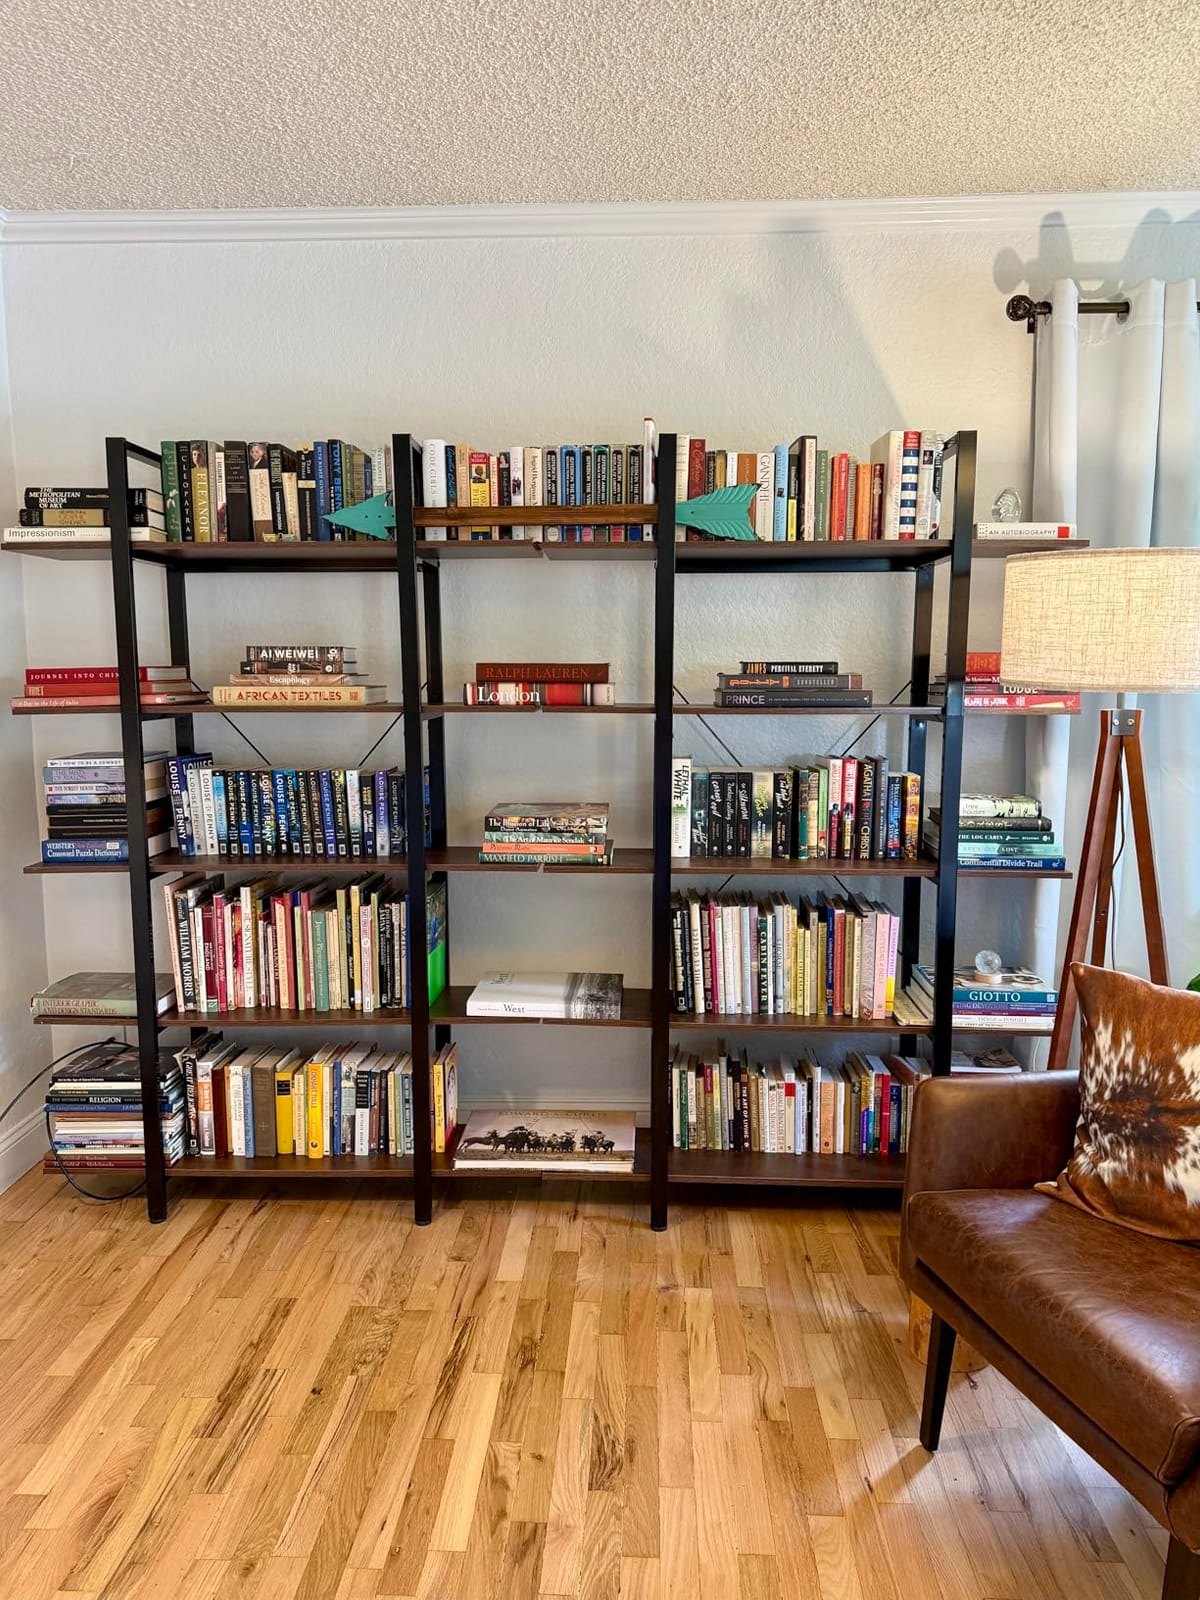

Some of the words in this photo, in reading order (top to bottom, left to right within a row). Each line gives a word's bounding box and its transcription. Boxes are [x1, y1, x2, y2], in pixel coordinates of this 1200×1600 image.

[333, 443, 341, 474] TONY
[759, 455, 771, 502] GANDHI
[28, 491, 81, 500] METROPOLITAN
[181, 455, 192, 533] CLEOPATRA
[197, 473, 209, 534] ELEANOR
[8, 528, 76, 539] Impressionism
[1001, 529, 1056, 537] AUTOBIOGRAPHY
[260, 649, 272, 659] AI
[275, 649, 319, 659] WEIWEI
[30, 671, 69, 681] JOURNEY
[73, 671, 95, 680] INTO
[98, 671, 120, 679] CHIN
[485, 666, 530, 679] RALPH
[535, 667, 590, 679] LAUREN
[745, 662, 767, 674] JAMES
[798, 663, 824, 673] EVERETT
[236, 690, 288, 702] AFRICAN
[290, 690, 342, 702] TEXTILES
[477, 686, 540, 703] London
[725, 695, 766, 705] PRINCE
[189, 777, 199, 806] LOUISE
[202, 773, 212, 802] LOUISE
[227, 776, 235, 802] LOUISE
[261, 774, 271, 805] LOUISE
[276, 773, 285, 804] LOUISE
[287, 776, 295, 801] LOUISE
[298, 777, 306, 801] LOUISE
[309, 777, 317, 802] LOUISE
[321, 778, 329, 802] LOUISE
[334, 778, 342, 803] LOUISE
[378, 776, 386, 801] LOUISE
[673, 769, 682, 801] WHITE
[681, 765, 690, 797] LETHAL
[863, 764, 873, 797] AGATHA
[168, 760, 181, 795] LOUISE
[175, 808, 187, 840] PENNY
[391, 780, 399, 806] LOUISE
[289, 801, 297, 826] PENNY
[300, 802, 308, 826] PENNY
[312, 802, 320, 826] PENNY
[324, 803, 332, 827] PENNY
[336, 803, 344, 828] PENNY
[378, 802, 387, 825] PENNY
[392, 806, 400, 830] PENNY
[488, 818, 501, 828] The
[192, 813, 201, 841] PENNY
[206, 813, 215, 841] PENNY
[264, 815, 273, 843] PENNY
[278, 814, 287, 842] PENNY
[971, 833, 984, 841] LOG
[984, 833, 1004, 841] CABIN
[75, 848, 94, 858] Puzzle
[95, 848, 123, 858] Dictionary
[860, 825, 871, 860] CHRISTIE
[1001, 846, 1019, 854] LOST
[483, 853, 526, 864] MAXFIELD
[527, 854, 563, 864] PARRISH
[959, 858, 1003, 868] Continental
[1002, 858, 1027, 868] Divide
[1026, 859, 1043, 869] Trail
[178, 920, 190, 958] WILLIAM
[759, 931, 768, 964] CABIN
[183, 961, 194, 997] MORRIS
[760, 968, 769, 1002] FEVER
[41, 998, 71, 1008] INTERIOR
[71, 999, 98, 1008] GRAPHIC
[502, 1003, 525, 1014] West
[968, 990, 1022, 1003] GIOTTO
[43, 1006, 60, 1015] AND
[60, 1006, 78, 1015] DESIGN
[78, 1006, 117, 1016] STANDARDS
[184, 1060, 195, 1084] GREAT
[88, 1096, 122, 1104] RELIGION
[185, 1084, 196, 1120] RELIGIONS
[743, 1109, 750, 1118] OF
[743, 1118, 751, 1139] LIVING
